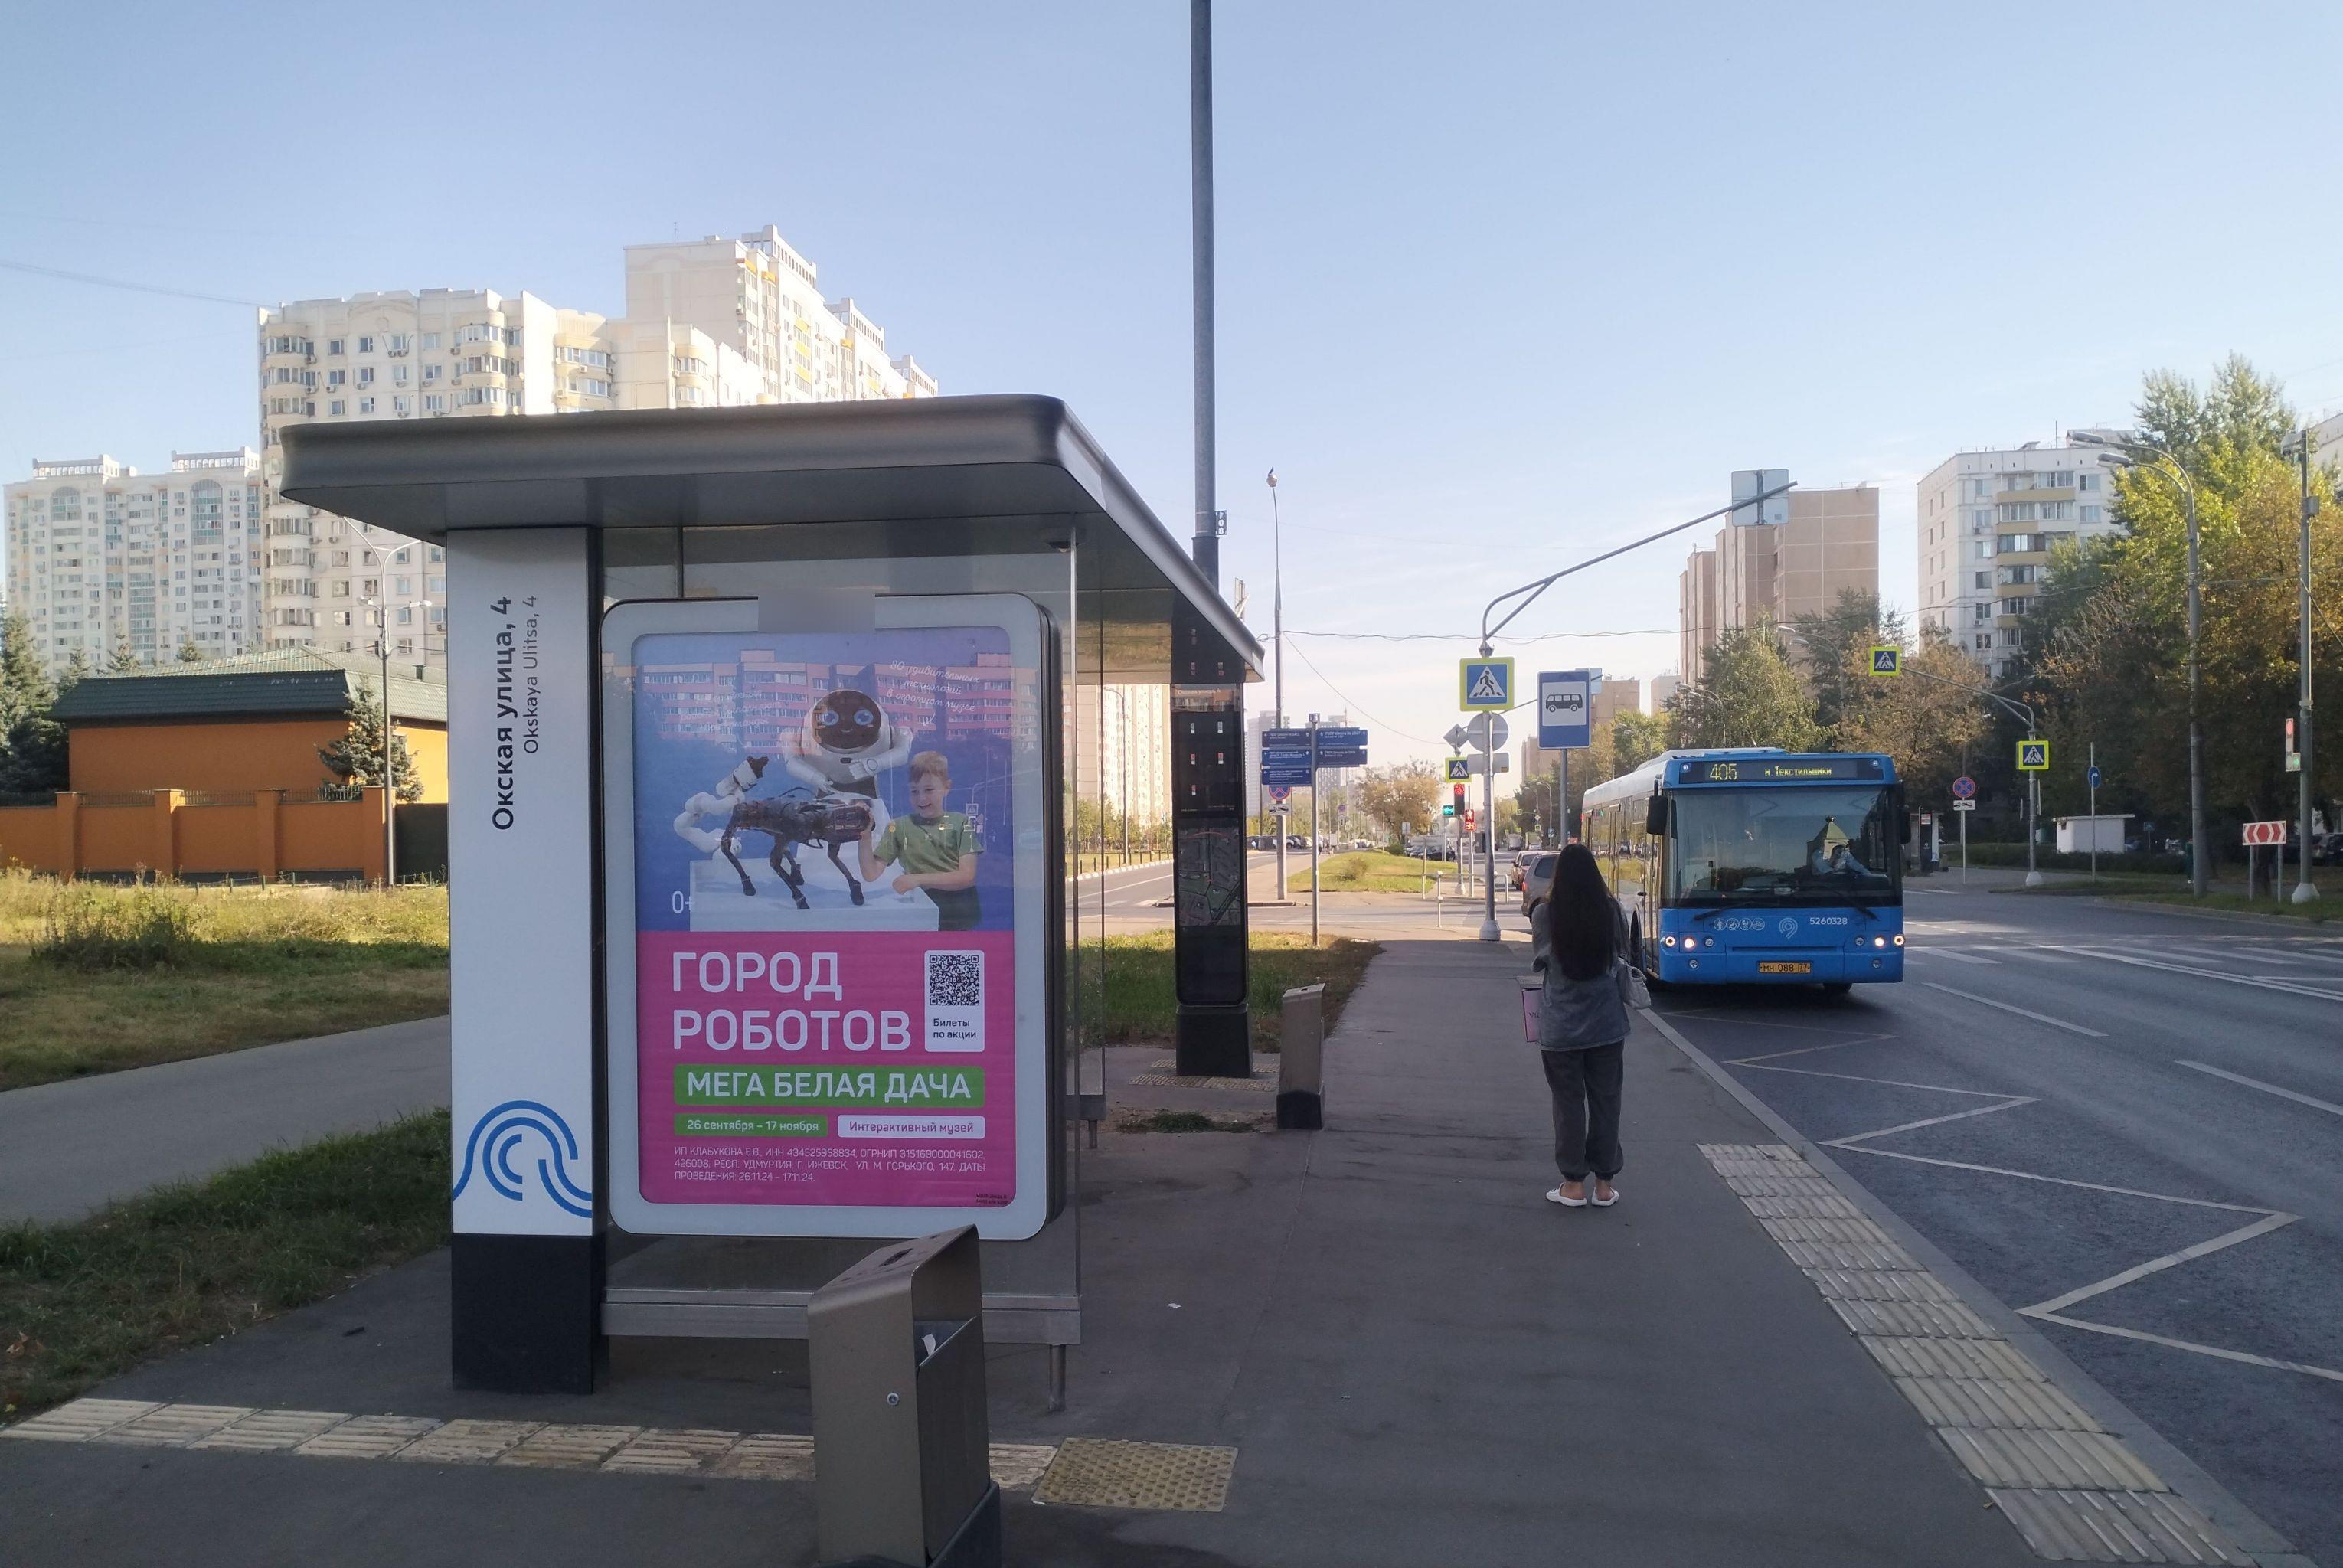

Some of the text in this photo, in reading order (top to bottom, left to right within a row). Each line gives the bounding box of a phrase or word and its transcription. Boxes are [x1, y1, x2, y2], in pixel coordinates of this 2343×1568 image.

[523, 595, 542, 754] Okskaya Ulitsa, 4
[890, 660, 980, 683] 80 удивительных
[887, 688, 975, 714] в огромном музее
[490, 596, 518, 830] Окская улица, 4
[1710, 763, 1738, 781] 405
[672, 890, 694, 914] 0+
[672, 951, 843, 1001] ГОРОД
[674, 1009, 910, 1051] РОБОТОВ
[933, 1017, 971, 1028] Билеты
[947, 1030, 977, 1040] акции
[688, 1072, 972, 1103] МЕГА БЕЛАЯ ДАЧА
[687, 1119, 701, 1130] 26
[704, 1120, 755, 1132] сентября
[766, 1120, 777, 1131] 17
[779, 1121, 819, 1133] ноября
[849, 1120, 974, 1134] Интерактивный музей
[674, 1147, 687, 1155] ИП
[690, 1147, 743, 1156] КЛАБУКОВА
[765, 1148, 785, 1157] ИНН
[860, 1149, 897, 1158] ОГРНИП
[959, 1162, 985, 1173] ДАТЫ
